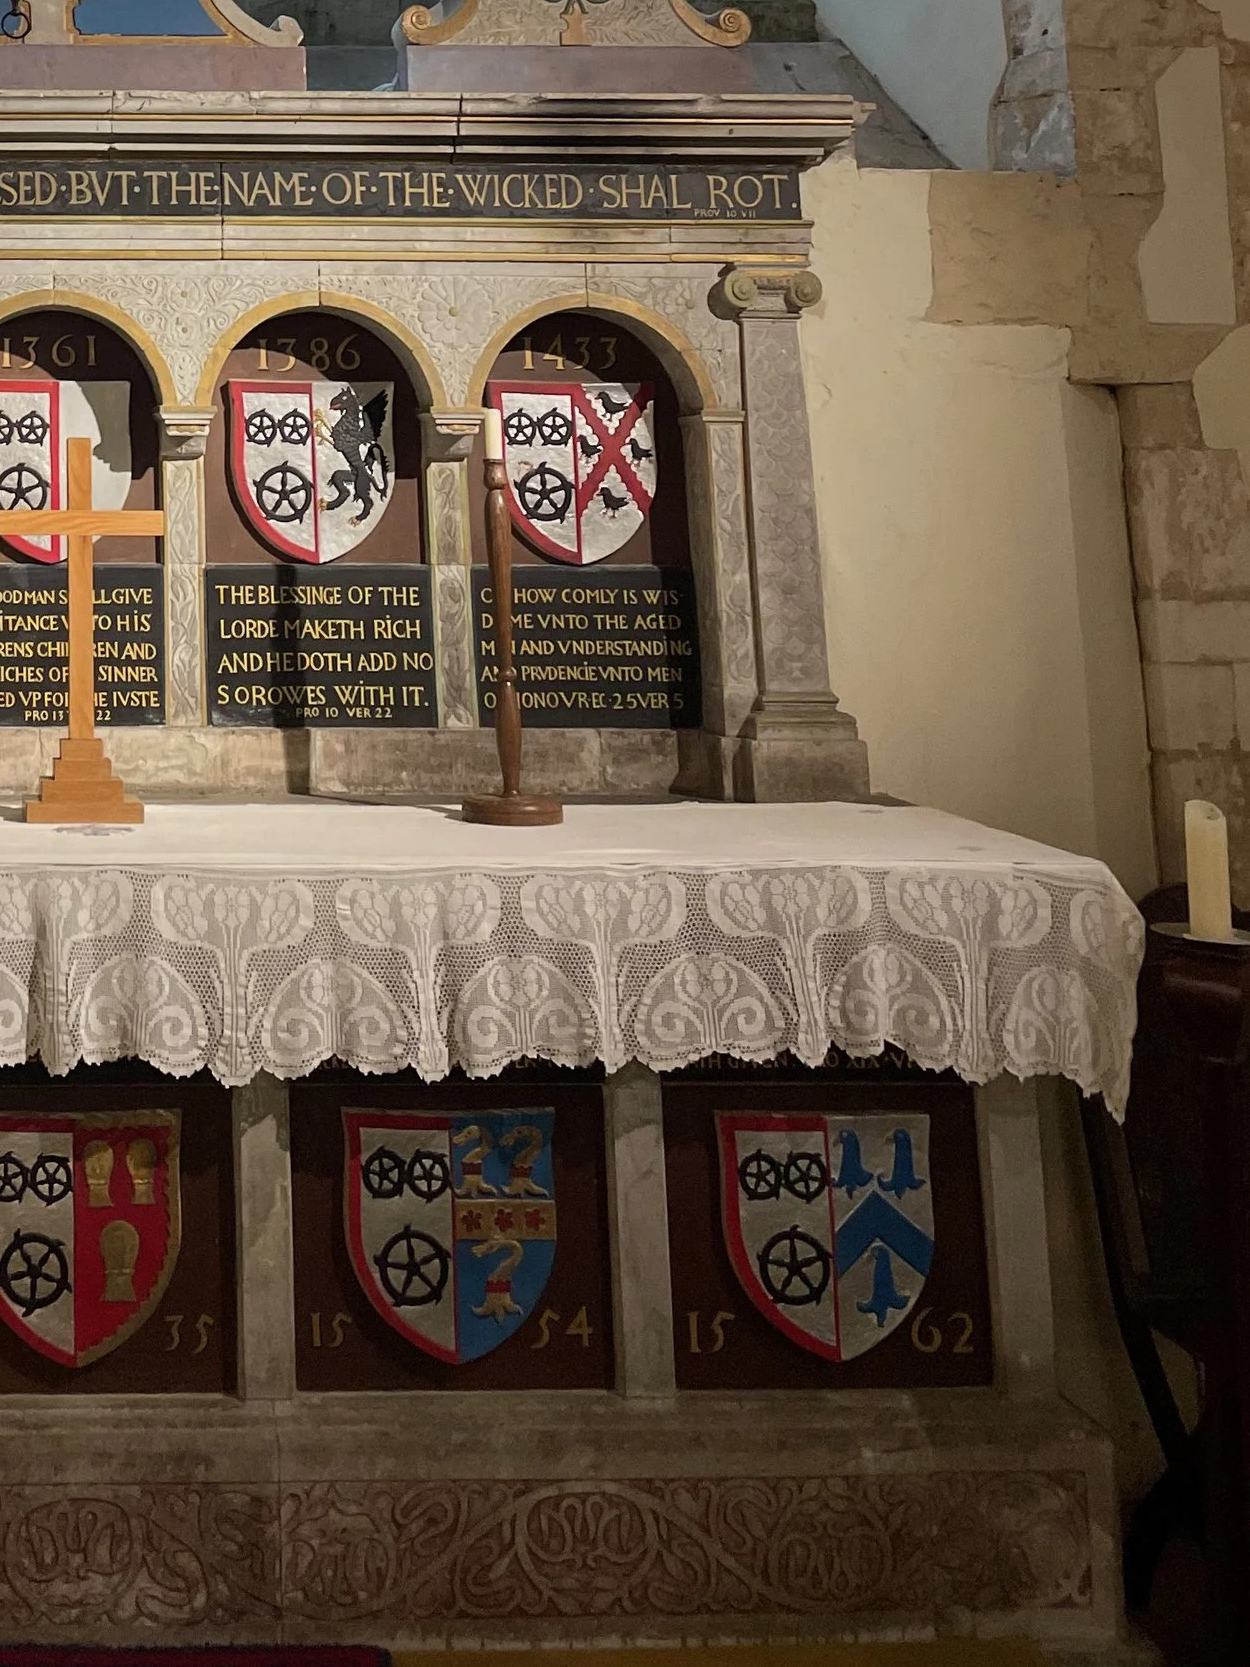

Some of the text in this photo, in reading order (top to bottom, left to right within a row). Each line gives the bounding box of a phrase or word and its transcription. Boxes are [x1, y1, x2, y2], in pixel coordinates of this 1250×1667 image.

[71, 172, 132, 206] BVT
[144, 172, 215, 207] THE
[223, 172, 309, 207] NAME
[323, 170, 371, 206] OF
[378, 170, 448, 207] THE
[457, 172, 582, 208] WICKED
[602, 174, 693, 209] SHAL
[1, 336, 97, 370] 1361
[256, 335, 363, 372] 1386
[522, 336, 619, 371] 1433
[24, 590, 55, 604] MAN
[59, 589, 112, 605] SLL
[112, 588, 152, 604] GIVE
[215, 585, 420, 606] THE BLESSINGE OF THE
[514, 589, 557, 604] HOW
[562, 589, 618, 604] COMLY
[623, 590, 638, 604] IS
[117, 610, 151, 632] HIS
[220, 615, 421, 639] LORDE MAKETH RICH
[482, 613, 681, 630] DME VNTO THE AGED
[120, 643, 157, 660] AND
[520, 640, 554, 656] AND
[557, 636, 692, 656] VNDERSTANDING
[217, 652, 433, 673] AND HE DOTH ADD NO
[49, 666, 69, 683] OF
[98, 665, 158, 682] SINNER
[599, 666, 643, 681] VNTO
[648, 667, 682, 681] MEN
[19, 692, 44, 707] VP
[112, 691, 160, 707] IVSTE
[333, 680, 394, 706] WITH
[636, 692, 669, 708] VER
[24, 710, 48, 721] PRO
[52, 710, 63, 721] 13
[96, 710, 111, 721] 22
[296, 708, 319, 718] PRO
[346, 708, 371, 718] VER
[375, 708, 392, 718] 22
[164, 1314, 214, 1354] 35
[311, 1307, 593, 1350] 15 54
[688, 1308, 975, 1353] 15 62
